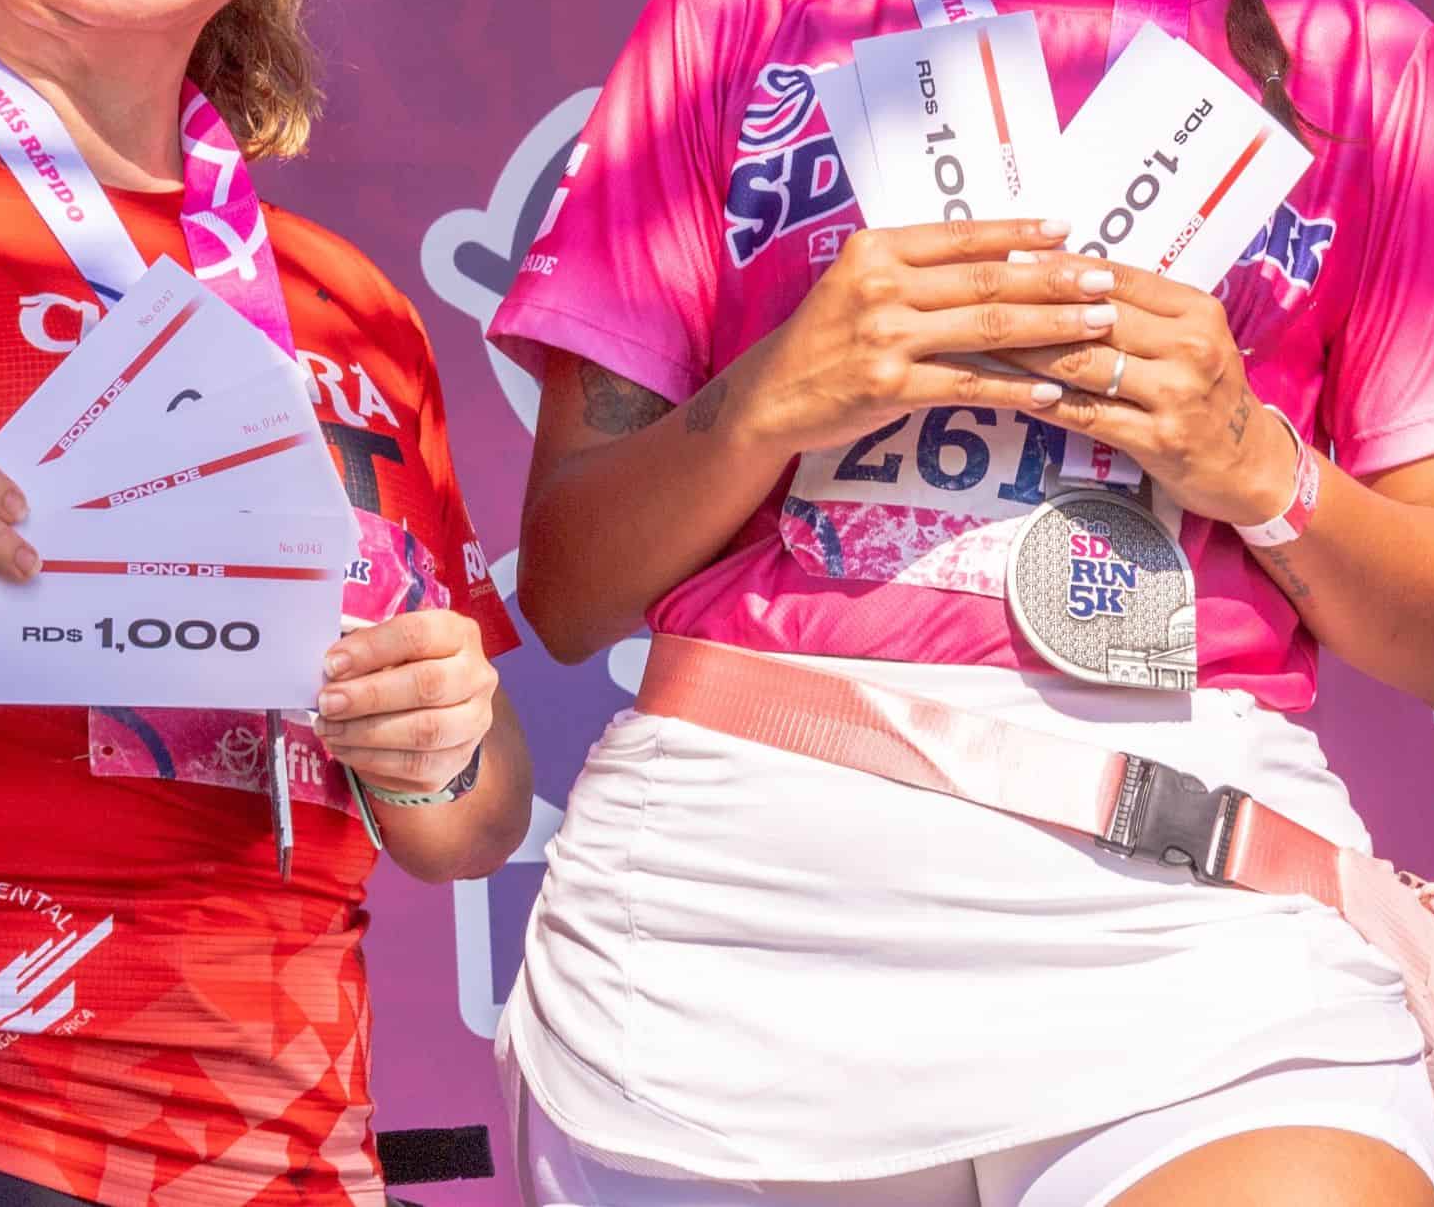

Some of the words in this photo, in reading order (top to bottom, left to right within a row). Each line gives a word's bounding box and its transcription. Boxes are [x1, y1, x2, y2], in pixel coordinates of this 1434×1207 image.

[20, 135, 85, 222] RÁPIDO
[925, 123, 974, 221] 1,00
[1166, 214, 1205, 263] BONO
[58, 403, 104, 451] BONO
[103, 377, 128, 403] DE
[108, 479, 168, 507] BONO
[173, 466, 201, 485] DE
[1070, 534, 1112, 560] SD
[126, 562, 191, 577] BONO
[197, 564, 226, 577] DE
[344, 560, 370, 584] K
[1070, 559, 1139, 589] RUN
[1068, 584, 1125, 618] 5K
[23, 627, 83, 643] RD$
[95, 618, 261, 653] 1,000
[287, 740, 323, 784] fit
